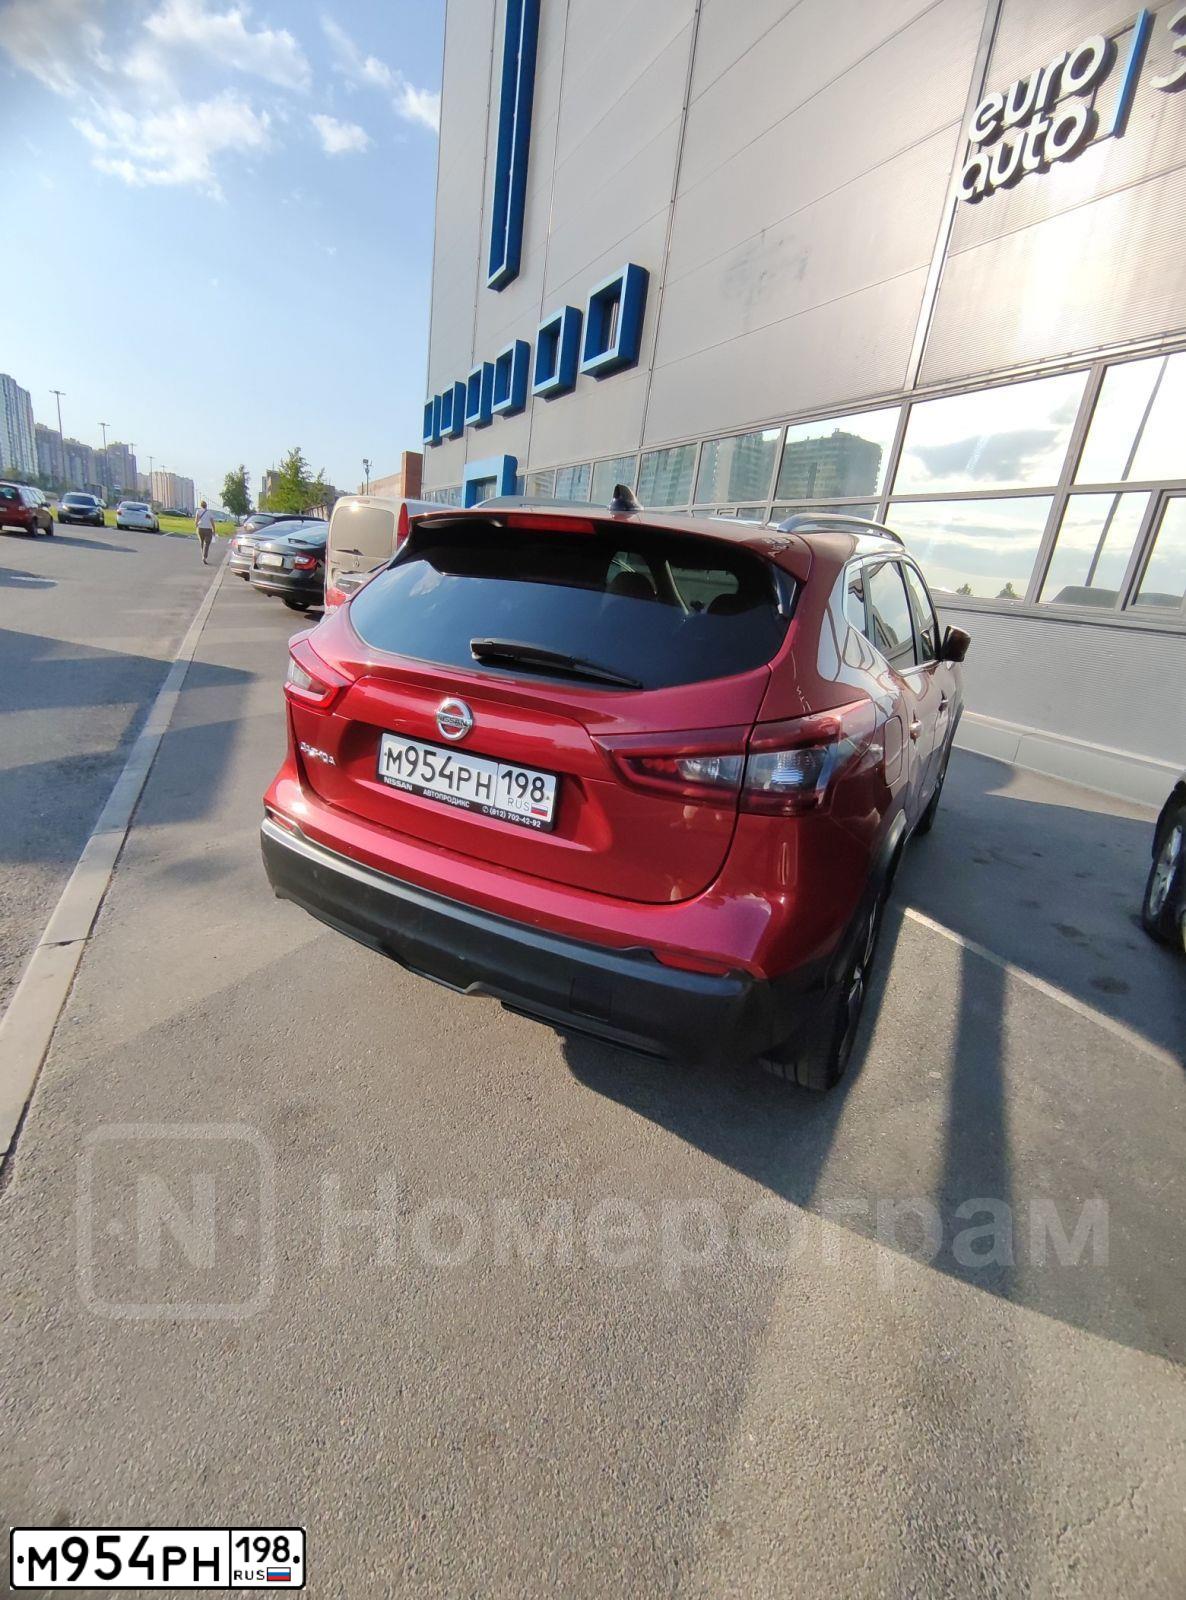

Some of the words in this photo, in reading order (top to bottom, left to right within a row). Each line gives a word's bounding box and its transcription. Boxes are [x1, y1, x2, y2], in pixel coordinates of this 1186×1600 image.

[969, 35, 1106, 142] euro
[956, 104, 1087, 200] auto
[383, 776, 413, 791] NISSAN
[386, 746, 492, 800] М954РН
[501, 769, 545, 803] 198
[423, 789, 470, 808] АВТОПРОДИКС
[508, 798, 530, 812] RUS
[489, 807, 506, 819] (812)
[507, 812, 541, 828] 702-42-92
